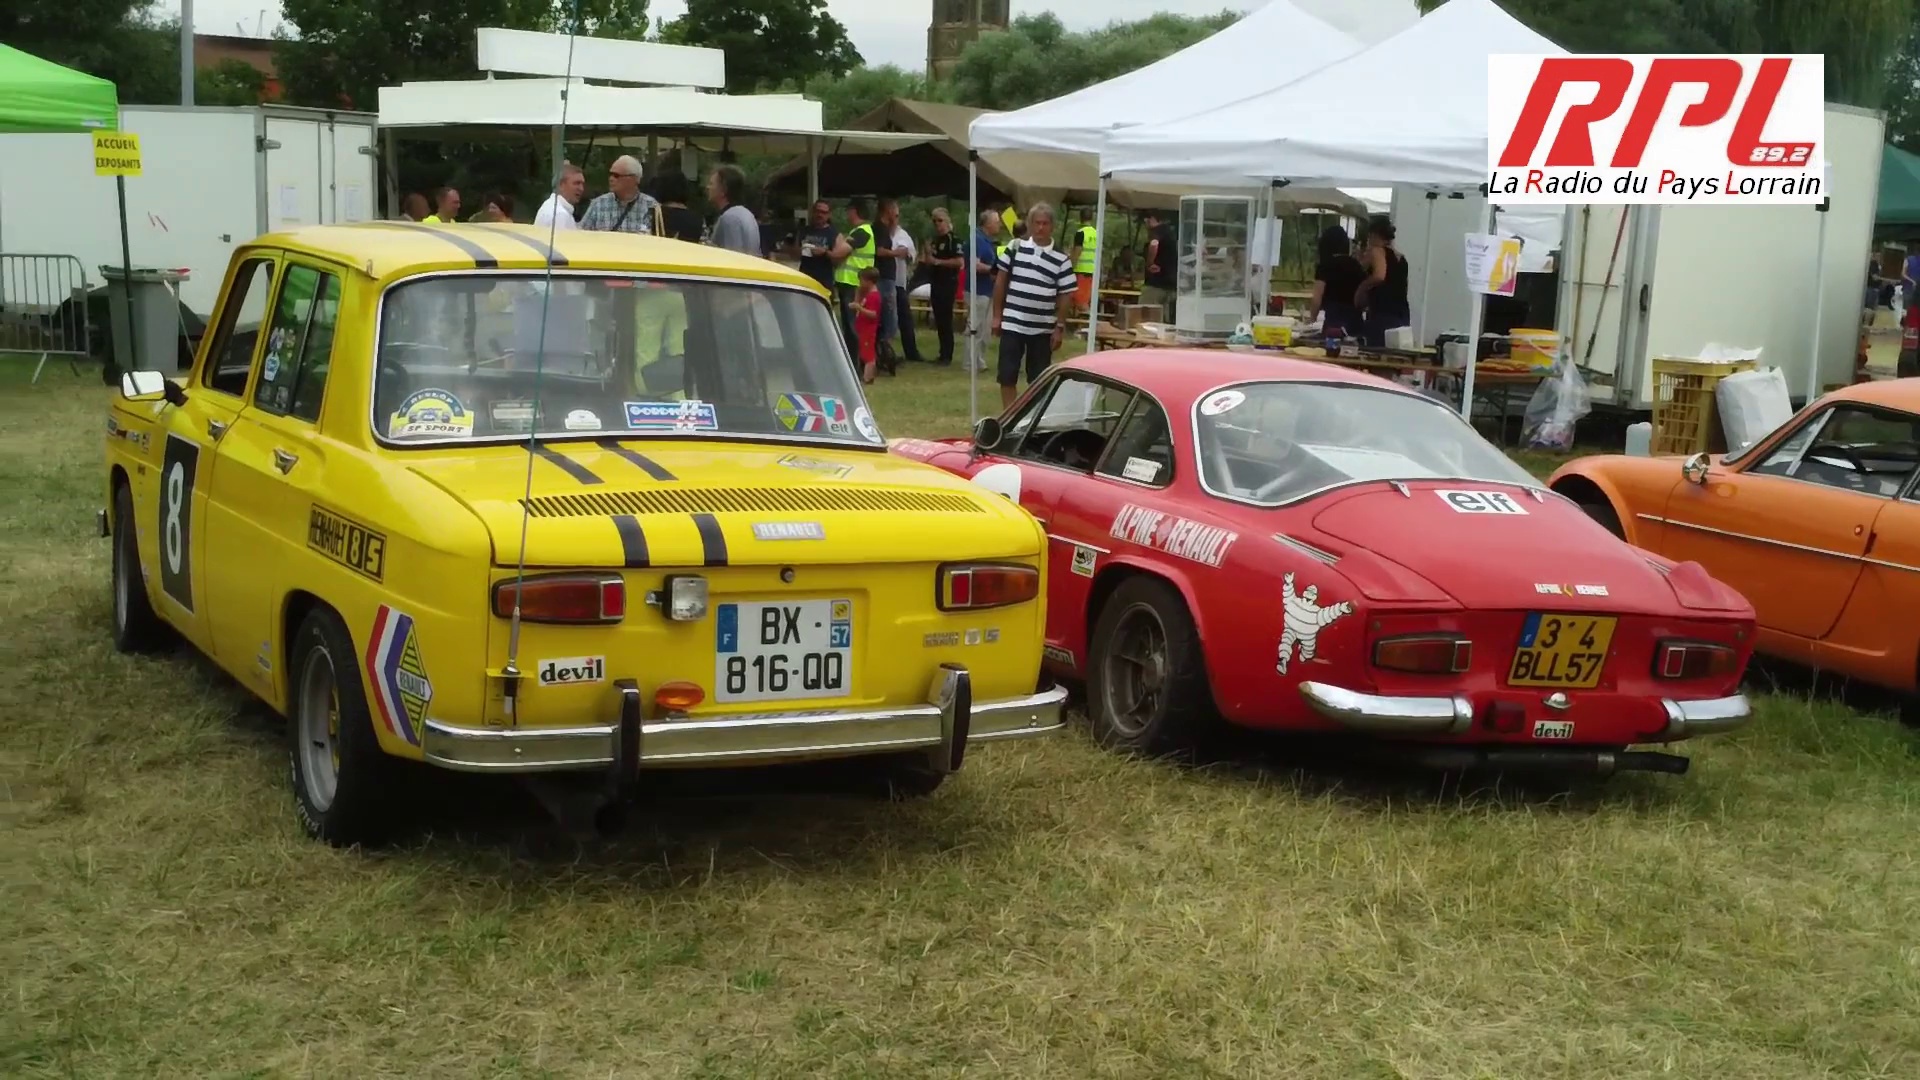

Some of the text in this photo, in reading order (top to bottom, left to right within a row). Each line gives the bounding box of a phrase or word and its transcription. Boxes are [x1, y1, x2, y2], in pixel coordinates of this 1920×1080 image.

[96, 138, 137, 150] ACCUEIL
[95, 157, 141, 169] EXPOSANTS
[425, 425, 465, 433] SPORT
[1447, 492, 1516, 513] elf
[166, 461, 184, 575] 8
[310, 508, 348, 559] RENAULT
[756, 523, 818, 537] RENAULT
[1111, 503, 1239, 567] ALPINE RENAULT
[723, 633, 732, 645] F
[831, 625, 849, 644] 57
[540, 658, 603, 683] devil
[726, 652, 843, 694] 816-QQ
[1512, 650, 1603, 683] BLL57
[399, 671, 426, 697] RENAULT
[1534, 721, 1573, 738] devil
